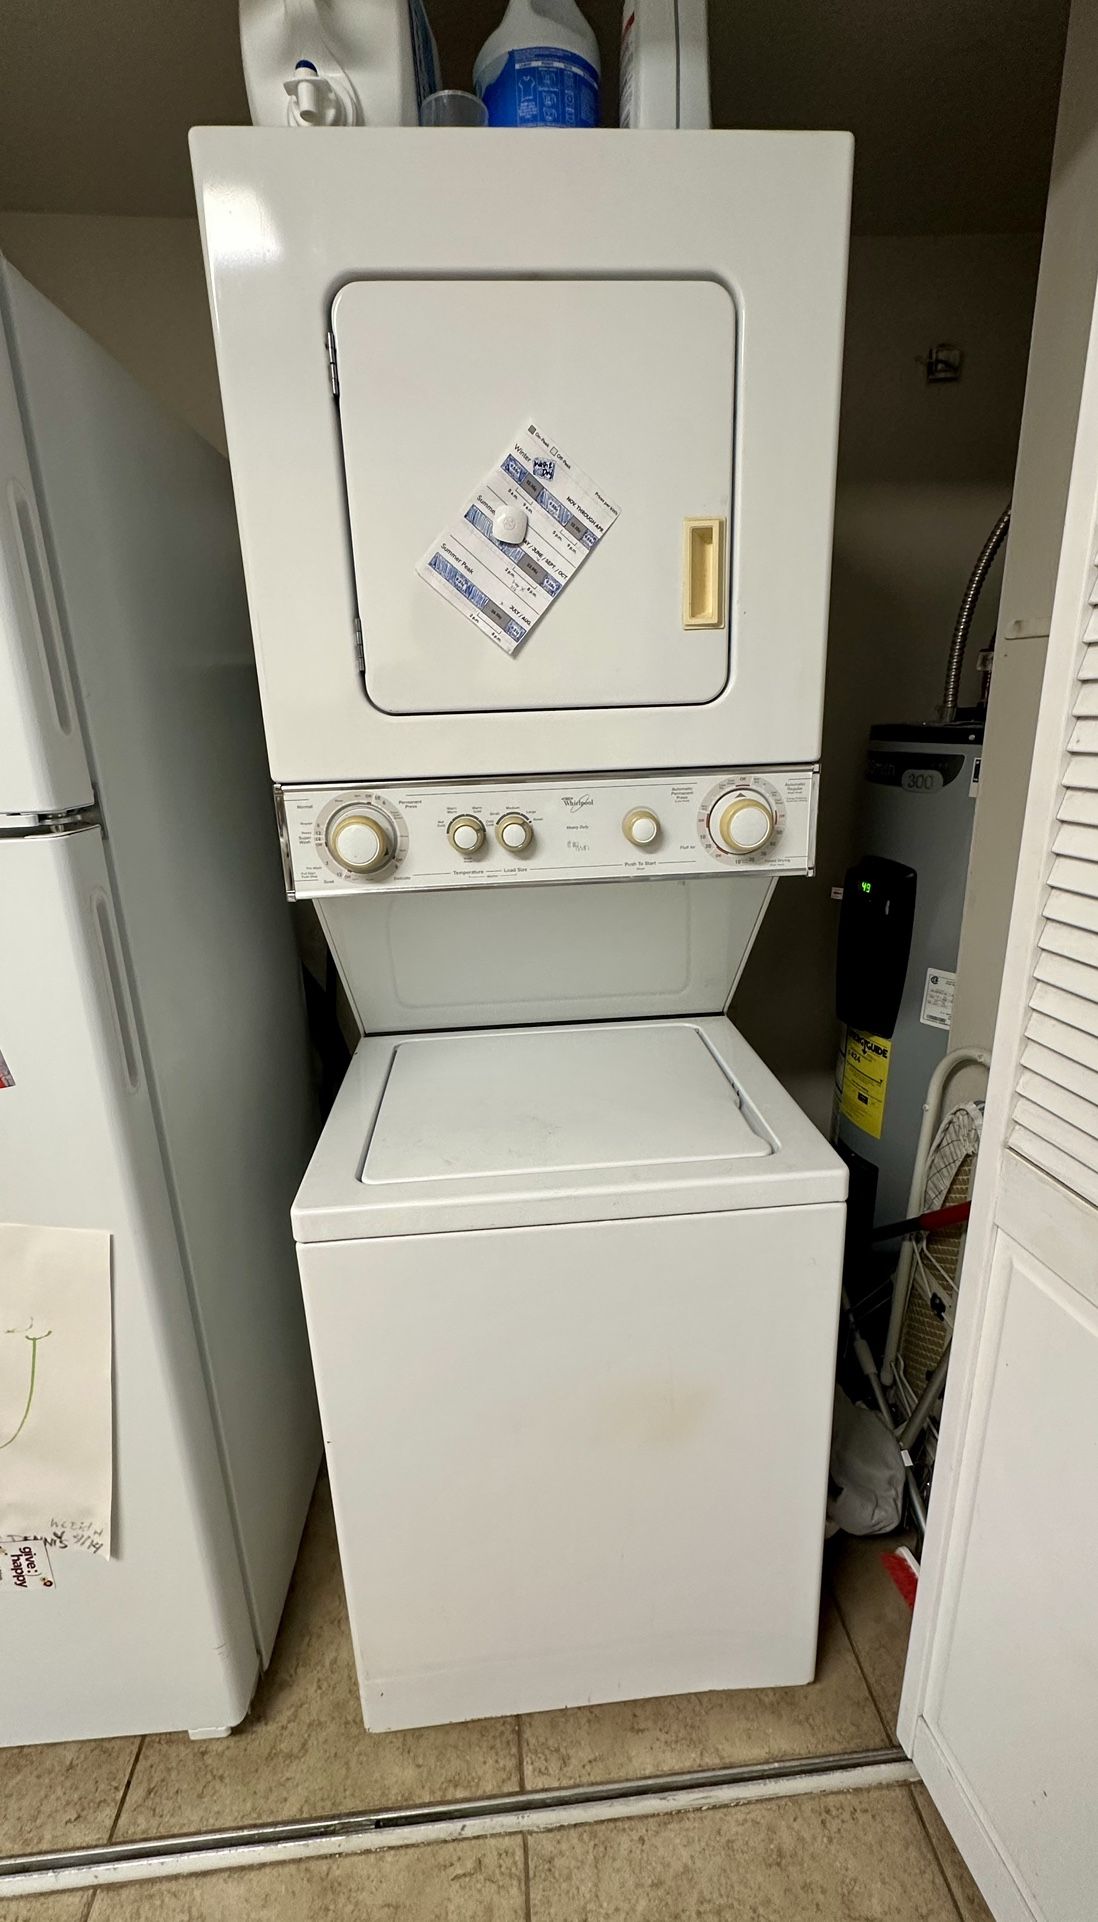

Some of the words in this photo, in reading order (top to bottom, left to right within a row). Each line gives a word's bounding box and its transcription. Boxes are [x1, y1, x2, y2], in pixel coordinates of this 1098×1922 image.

[514, 443, 531, 462] Winter
[477, 495, 495, 516] Summe
[576, 505, 597, 526] THROUGH
[441, 543, 462, 565] Summer
[461, 561, 474, 575] Peak
[907, 773, 934, 790] 300
[861, 881, 871, 893] 49
[10, 1554, 28, 1588] happy
